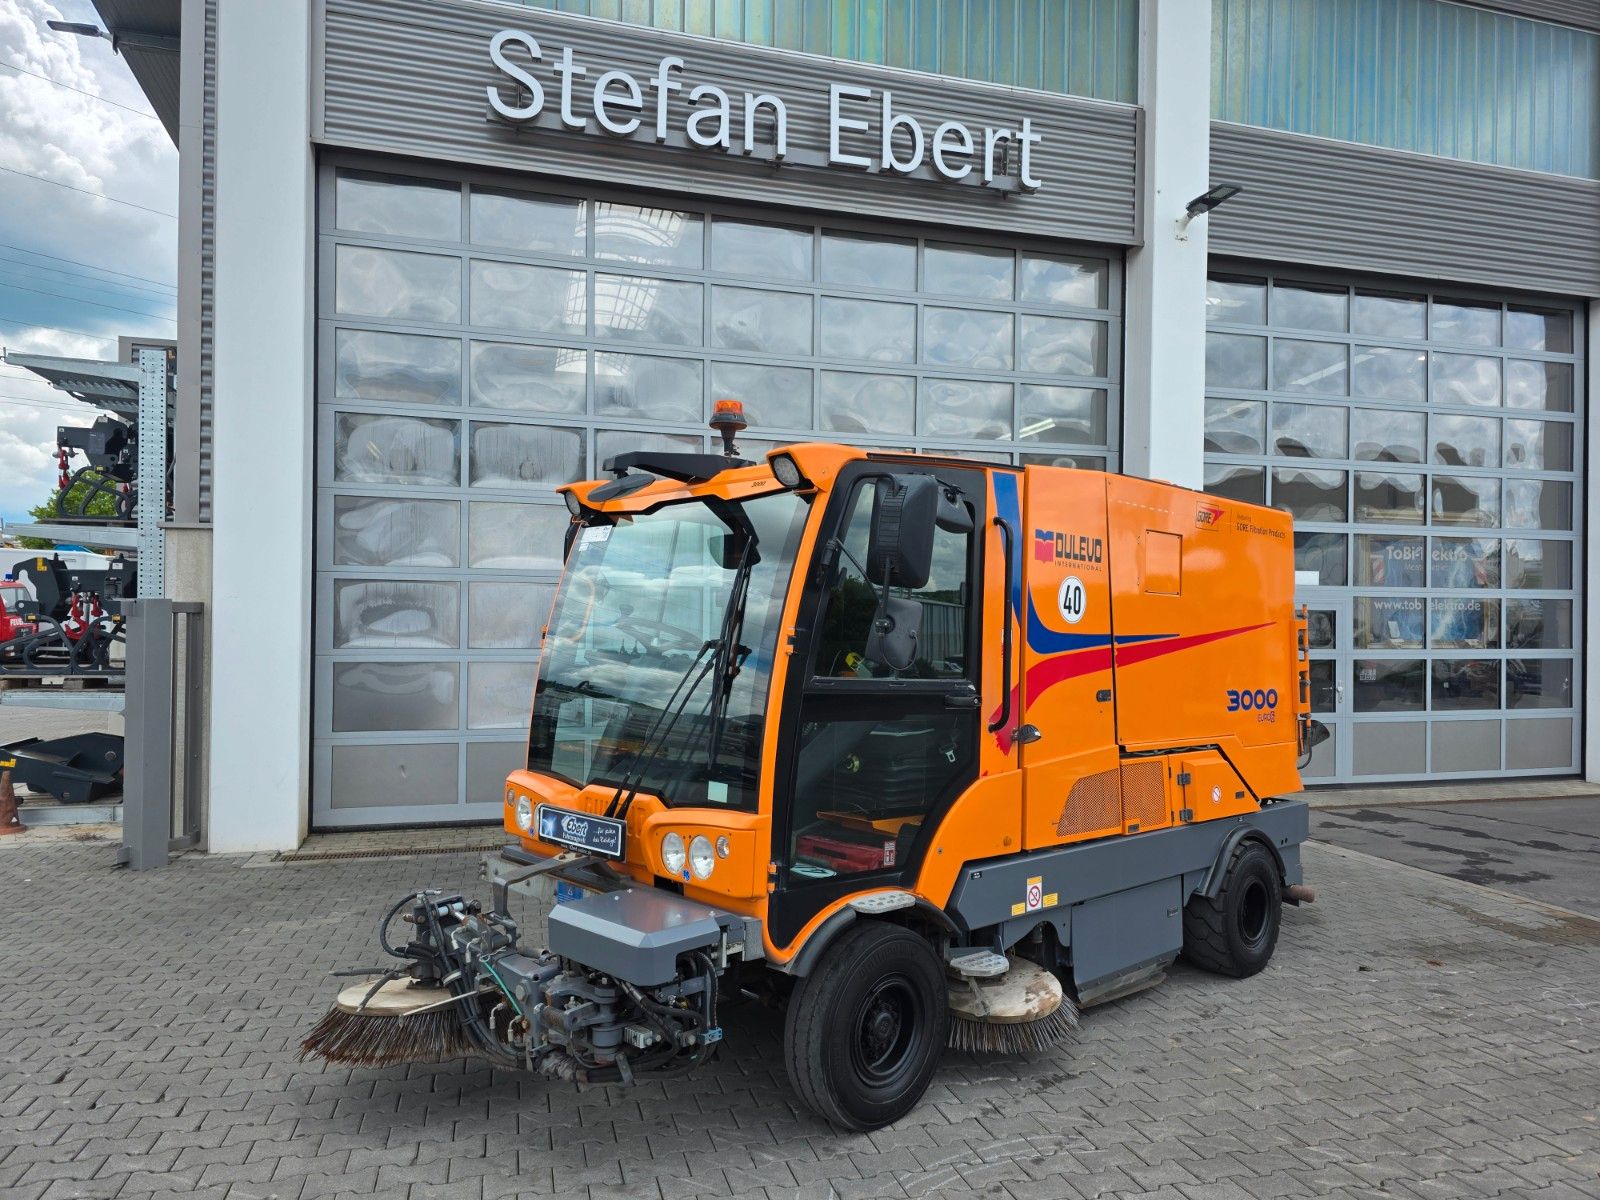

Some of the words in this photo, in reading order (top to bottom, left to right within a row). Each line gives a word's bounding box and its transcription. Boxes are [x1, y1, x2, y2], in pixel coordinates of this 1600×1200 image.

[485, 29, 789, 160] Stefan
[826, 82, 1043, 192] Ebert
[1197, 510, 1213, 524] GORE
[1055, 532, 1103, 564] DULEVO
[1054, 560, 1102, 572] INTERNATIONAL
[1063, 584, 1082, 615] 40
[1226, 688, 1278, 711] 3000
